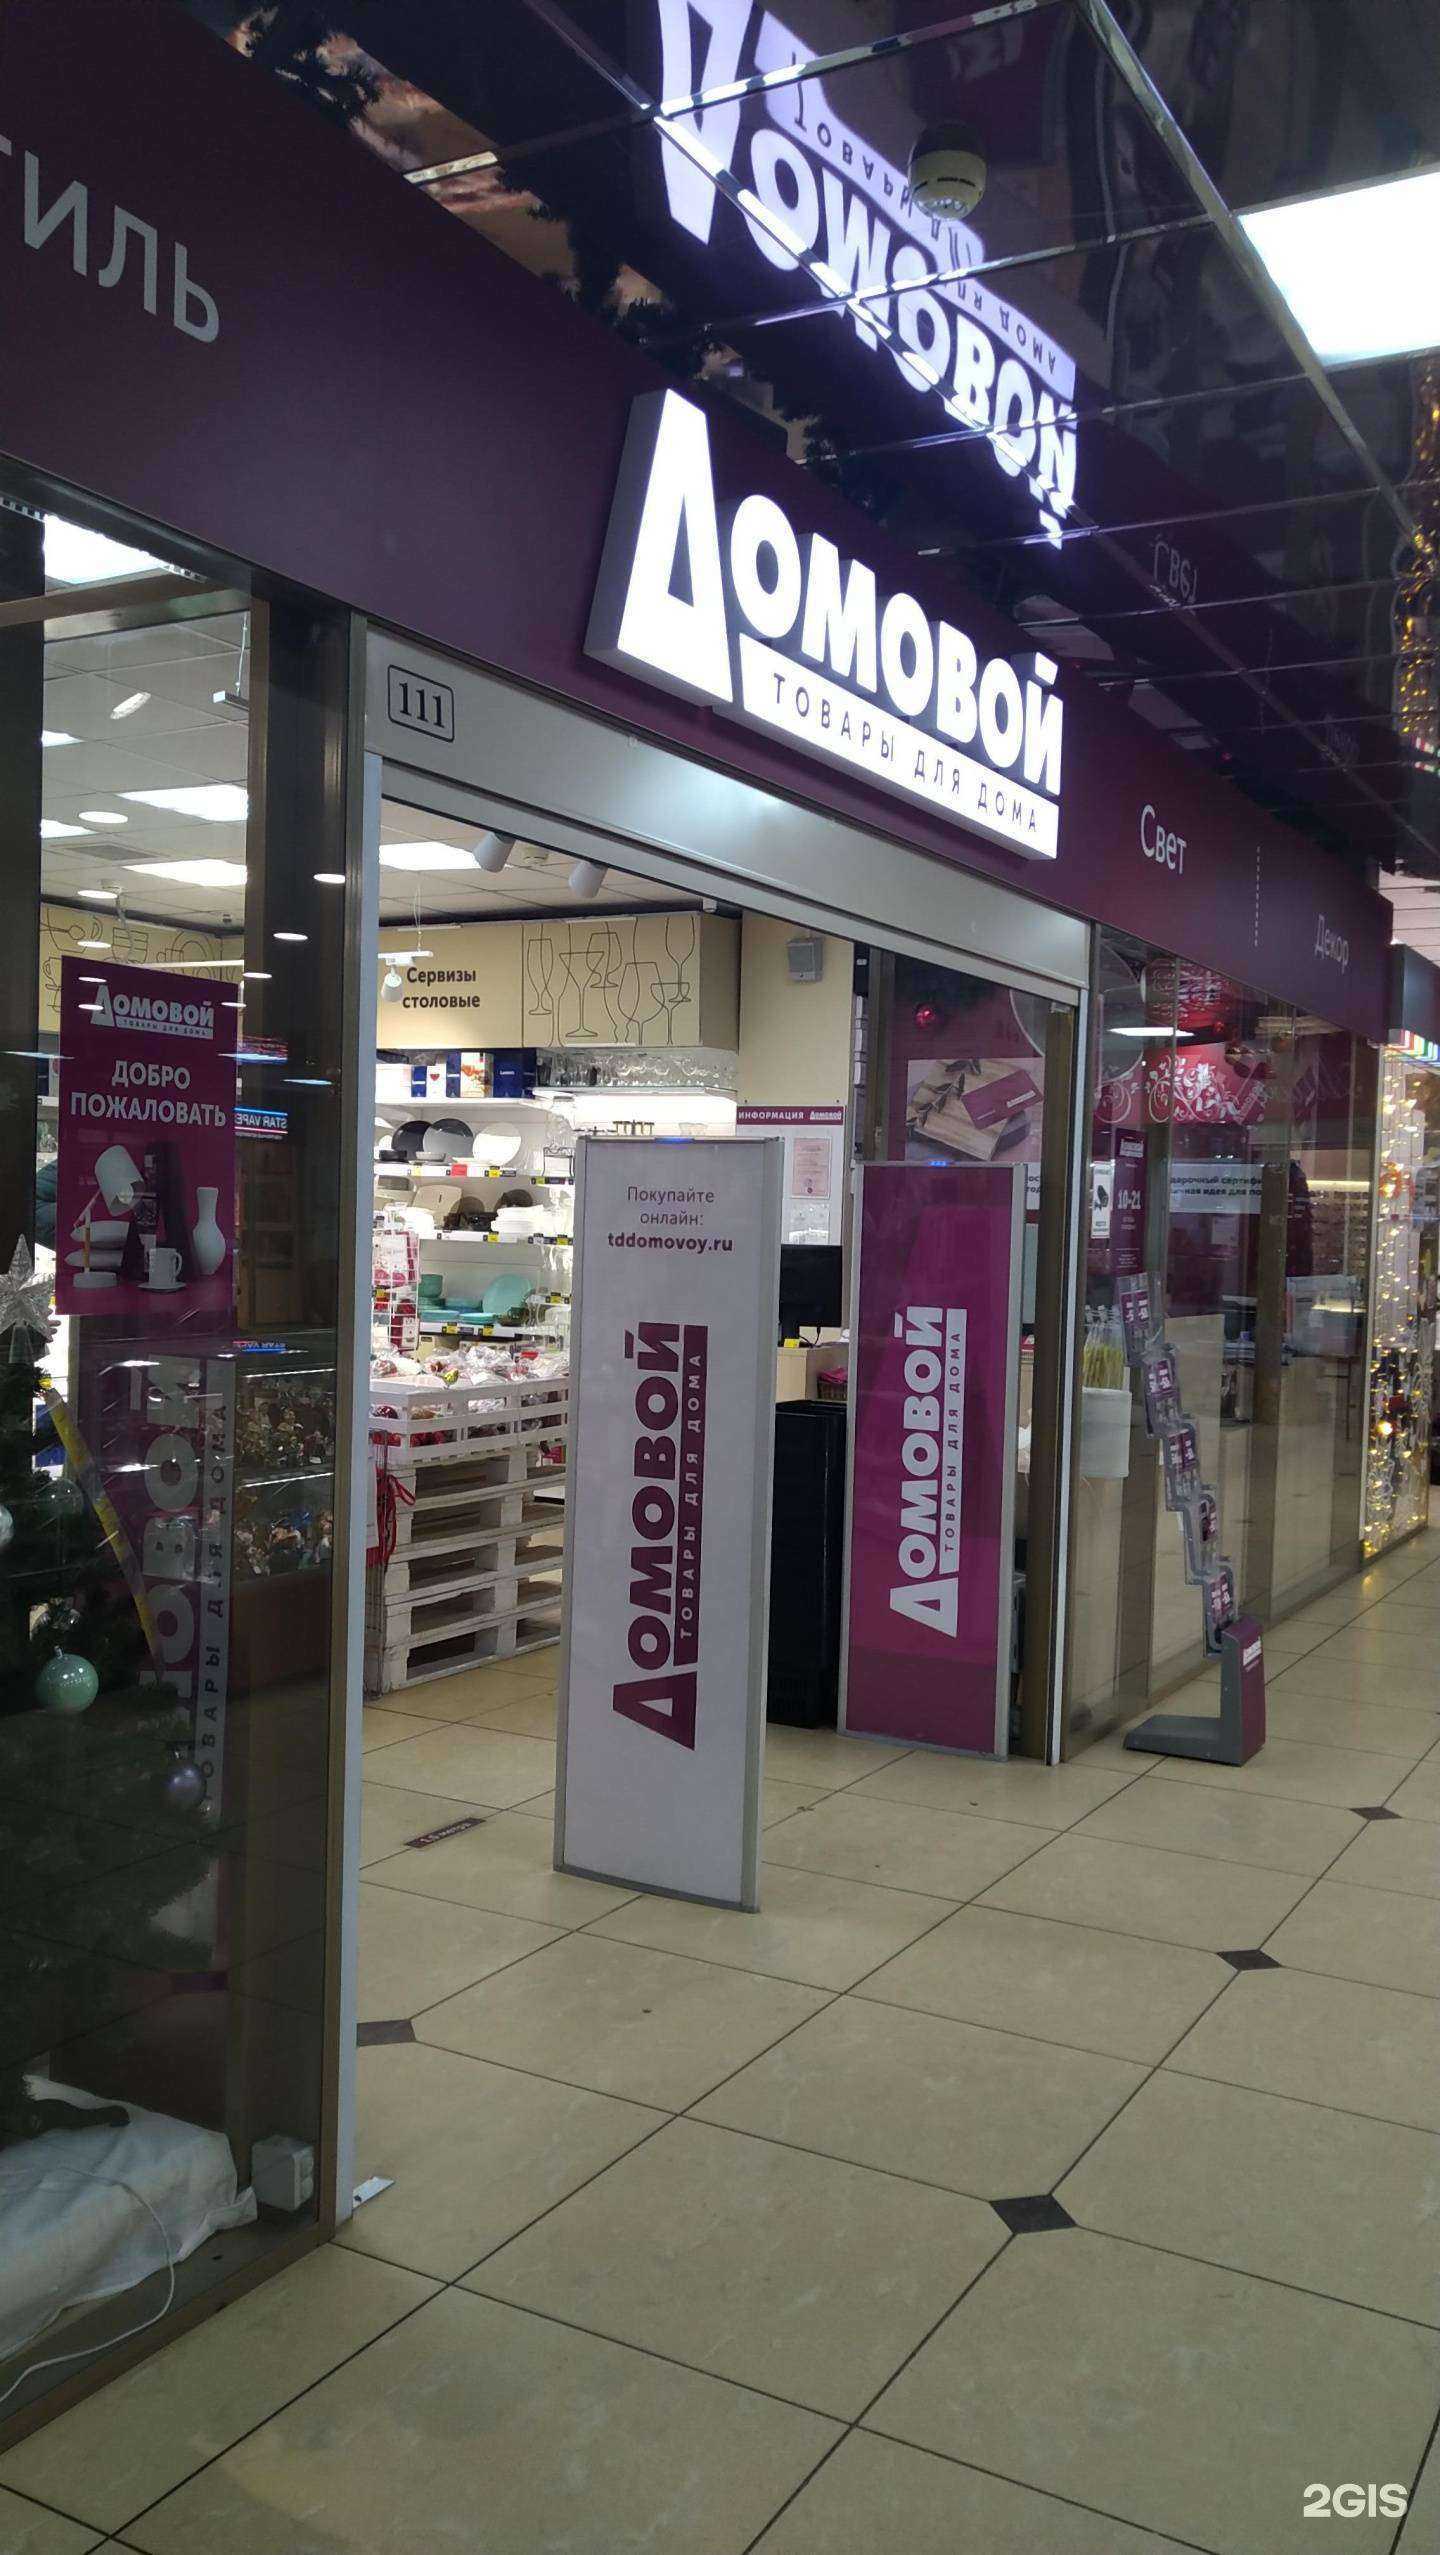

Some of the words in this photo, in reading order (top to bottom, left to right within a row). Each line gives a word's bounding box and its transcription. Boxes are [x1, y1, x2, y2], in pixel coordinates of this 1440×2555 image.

[398, 682, 445, 729] 111
[772, 672, 895, 762] ТОВАРЫ
[913, 749, 961, 793] ДЛЯ
[976, 782, 1037, 833] ДОМА
[1140, 804, 1187, 875] Свет
[1313, 913, 1350, 975] Декор
[406, 966, 476, 987] Сервизы
[402, 995, 481, 1009] столовые
[111, 1060, 191, 1090] ДОБРО
[70, 1091, 227, 1127] ПОЖАЛОВАТЬ
[738, 1111, 804, 1121] ИНФОРМАЦИЯ
[627, 1185, 716, 1206] Покупайте
[640, 1210, 704, 1226] онлайн:
[607, 1232, 734, 1254] tddomovoy.ru
[949, 1332, 961, 1394] ДОМА
[687, 1353, 702, 1434] ДОМА
[947, 1408, 960, 1451] ДЛЯ
[684, 1451, 699, 1507] ДЛЯ
[944, 1464, 958, 1553] ТОВАРЫ
[680, 1525, 697, 1640] ТОВАРЫ
